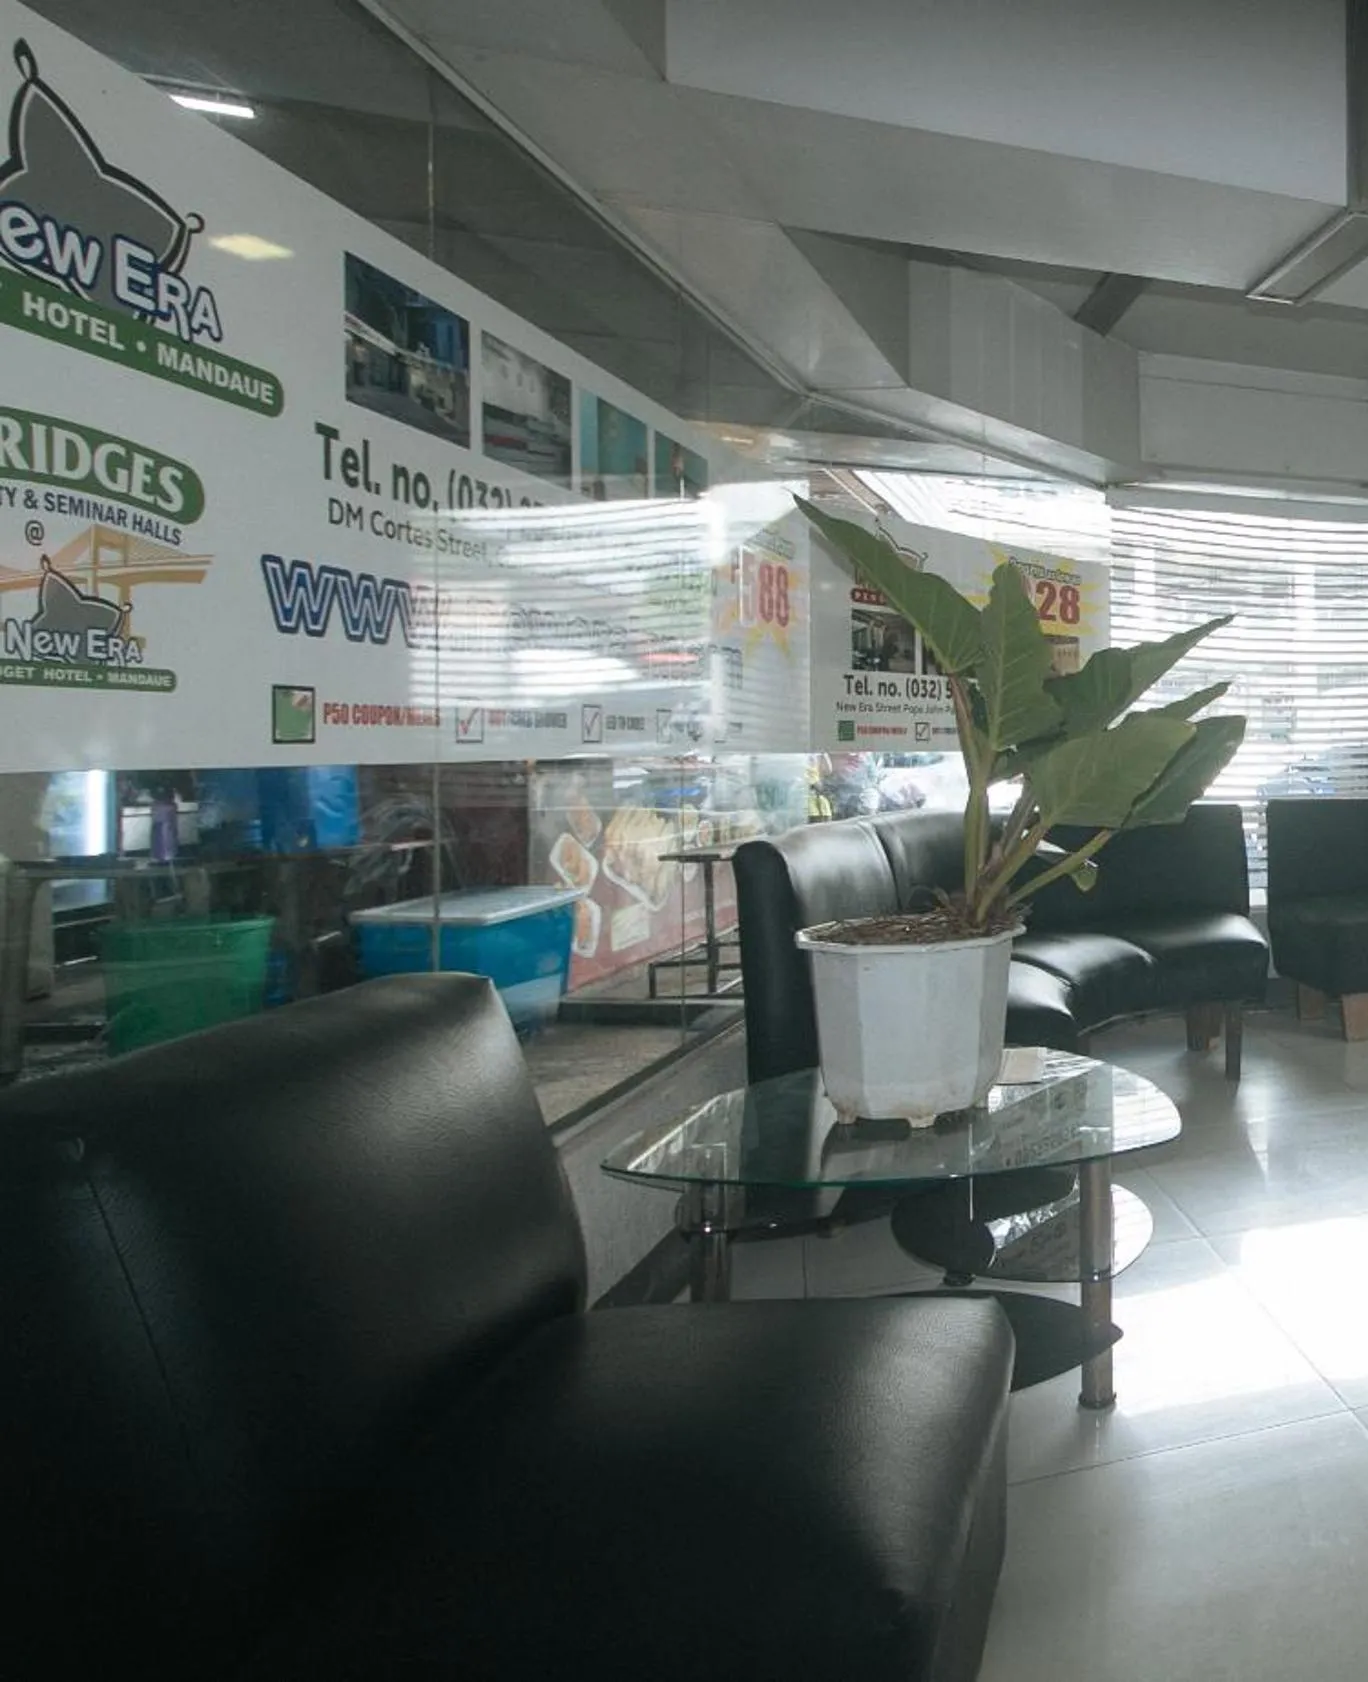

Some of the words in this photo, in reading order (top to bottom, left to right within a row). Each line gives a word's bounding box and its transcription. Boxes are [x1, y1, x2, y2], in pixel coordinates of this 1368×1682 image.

[112, 233, 223, 343] ERA
[22, 291, 126, 351] HOTEL
[157, 343, 274, 405] MANDAUE
[0, 415, 185, 513] RIDGES
[315, 422, 381, 495] Tel.
[23, 488, 39, 510] &
[44, 491, 128, 529] SEMINAR
[132, 512, 182, 546] HALLS
[25, 520, 45, 546] @
[328, 497, 365, 532] DM
[370, 510, 432, 549] Cortes
[6, 618, 80, 662] New
[87, 628, 144, 666] ERA
[43, 668, 93, 683] HOTEL
[843, 674, 873, 697] Tel.
[878, 680, 902, 698] no.
[905, 677, 942, 701] (032)
